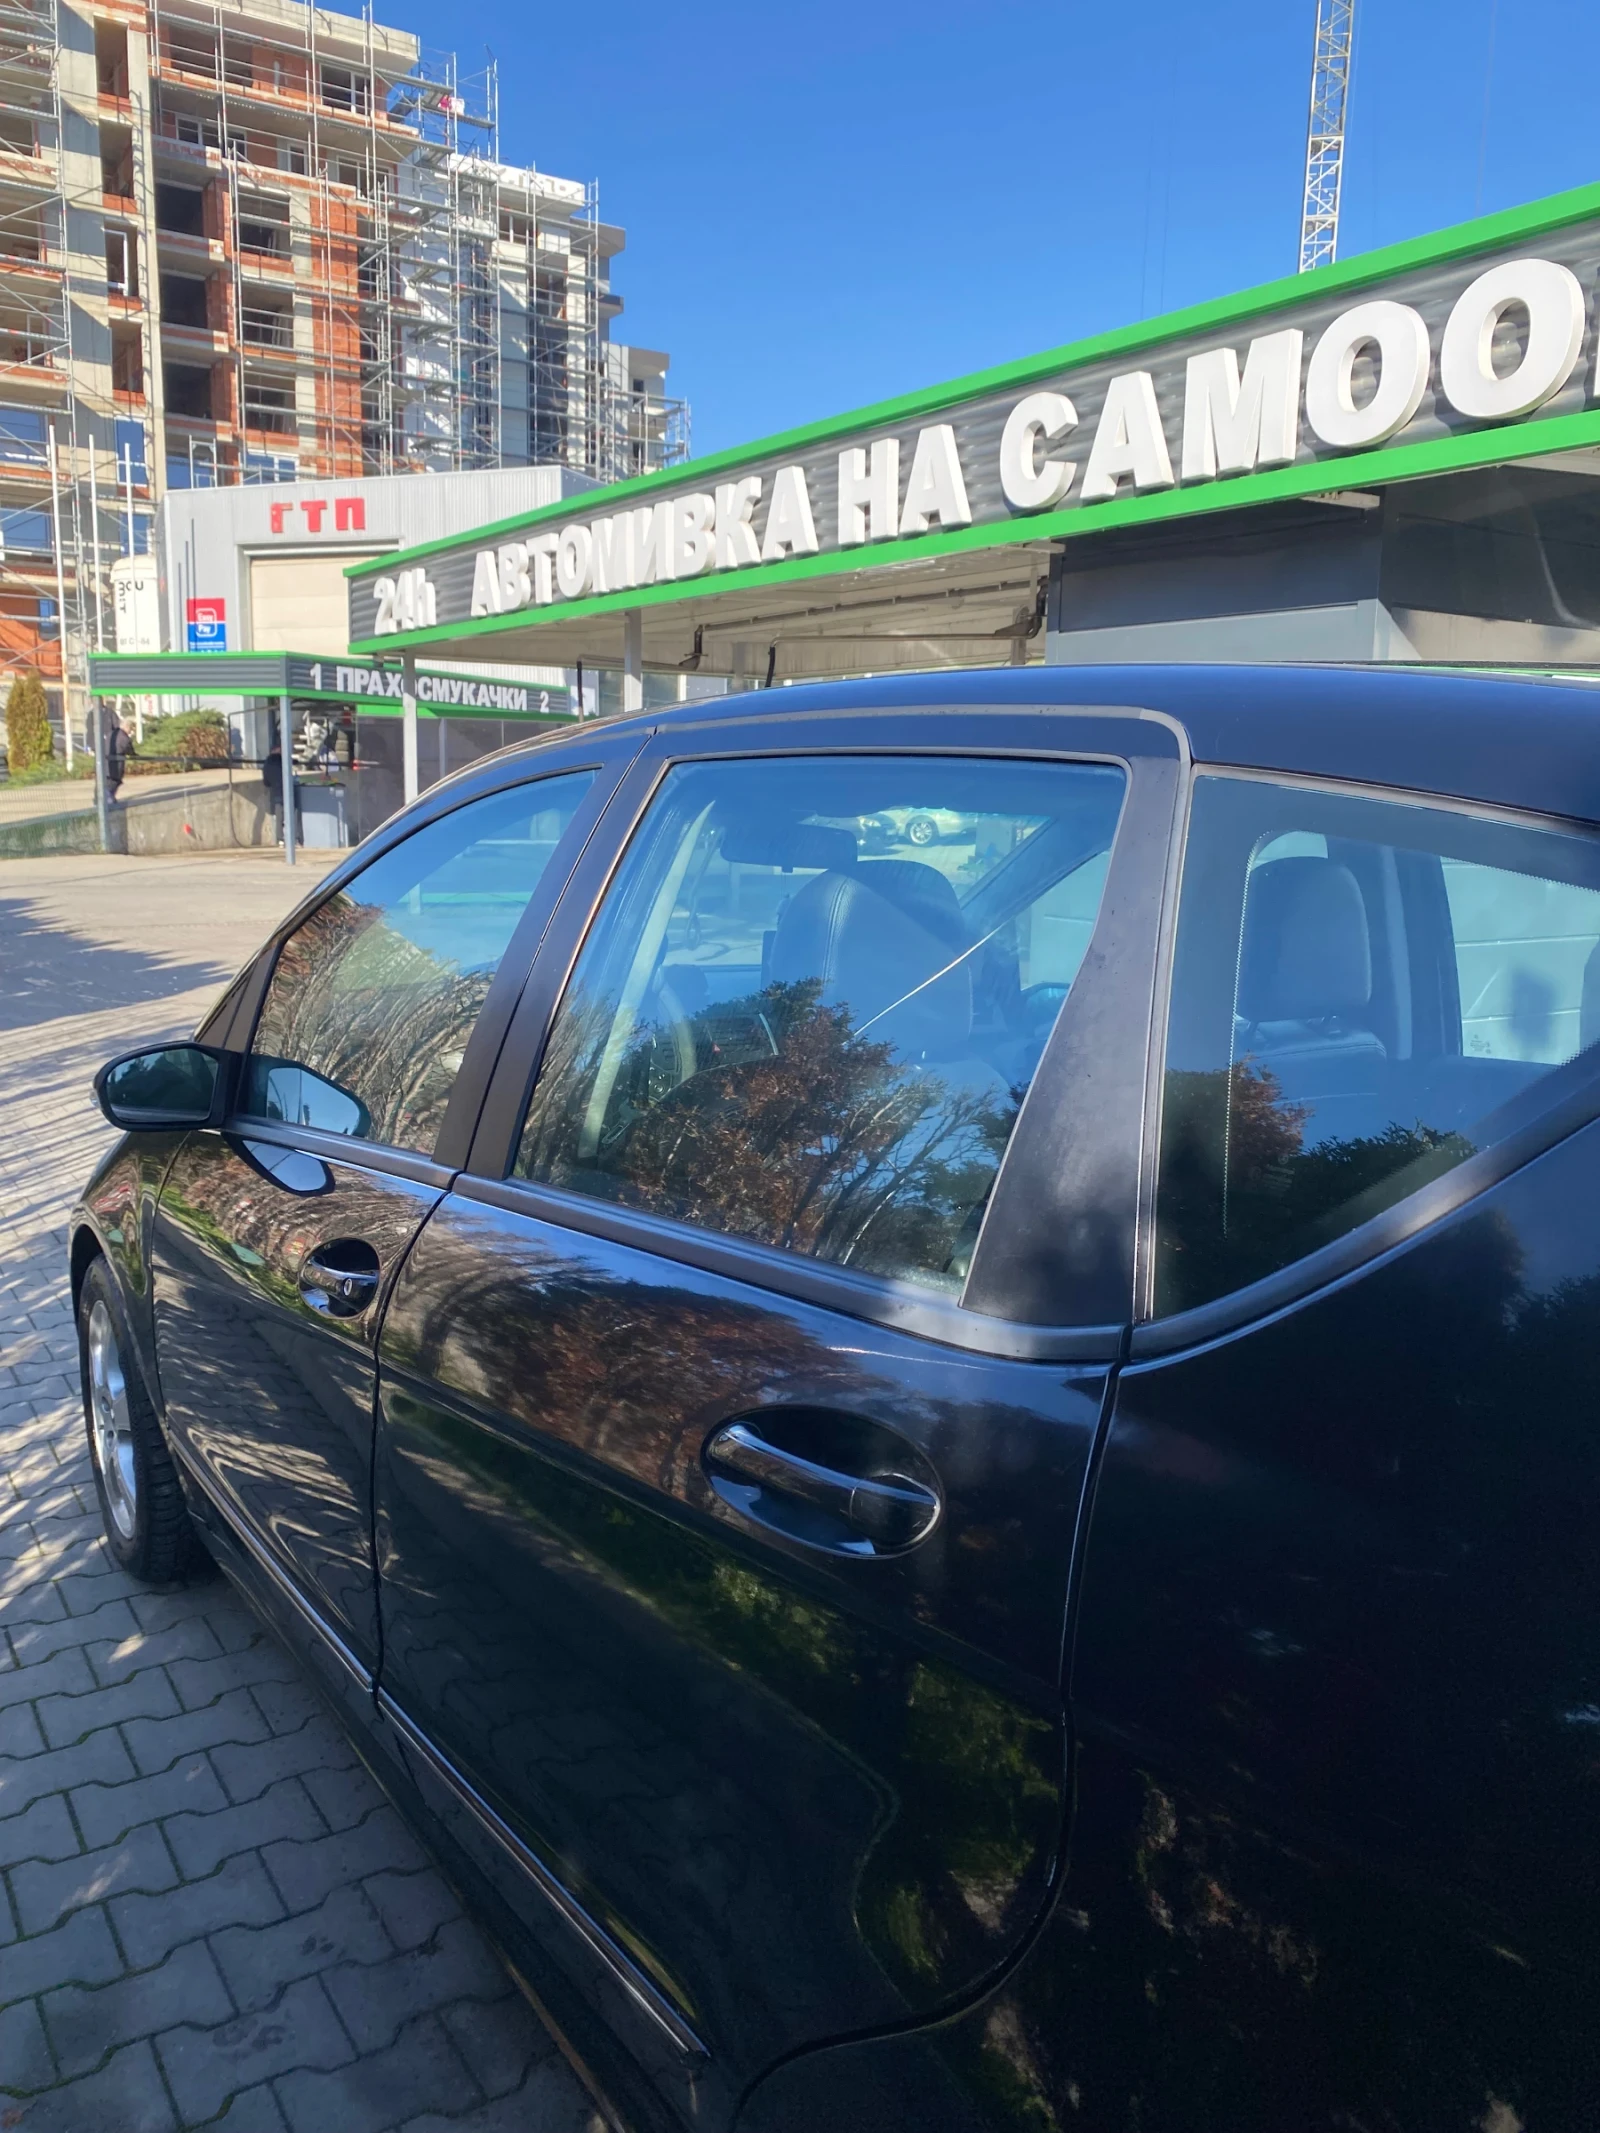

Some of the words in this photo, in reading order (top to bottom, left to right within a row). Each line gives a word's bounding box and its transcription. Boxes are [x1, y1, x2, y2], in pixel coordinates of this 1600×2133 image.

[373, 567, 437, 636] 24h
[470, 465, 819, 617] АВТОМИВКА
[838, 423, 972, 547] НА
[999, 257, 1600, 511] САМОО
[271, 498, 366, 534] ГТП
[310, 663, 322, 691] 1
[540, 690, 550, 713] 2
